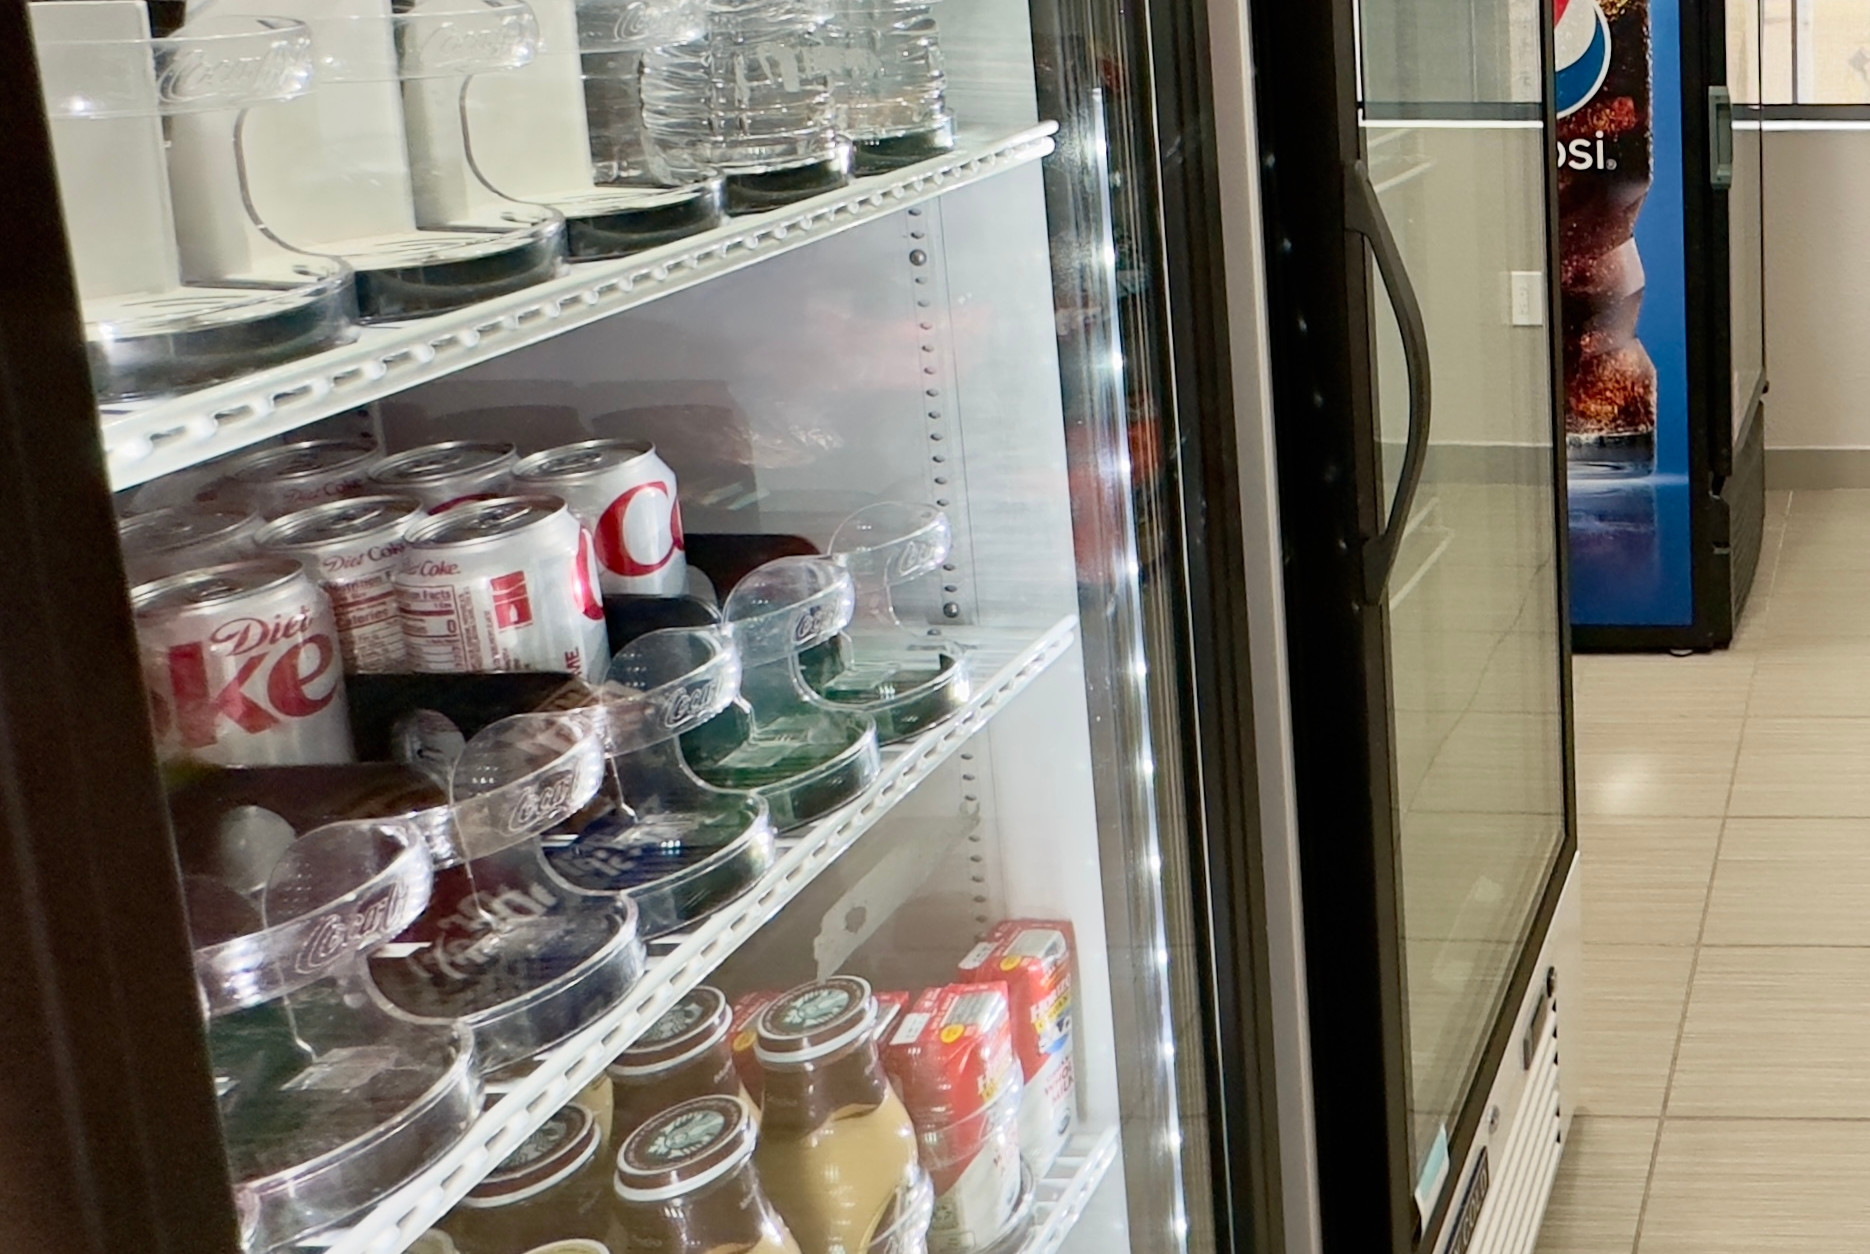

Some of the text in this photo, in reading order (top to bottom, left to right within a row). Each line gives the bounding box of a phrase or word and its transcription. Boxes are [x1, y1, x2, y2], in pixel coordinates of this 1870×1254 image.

[211, 604, 314, 657] Diet
[446, 618, 457, 634] 0
[150, 632, 339, 746] ke
